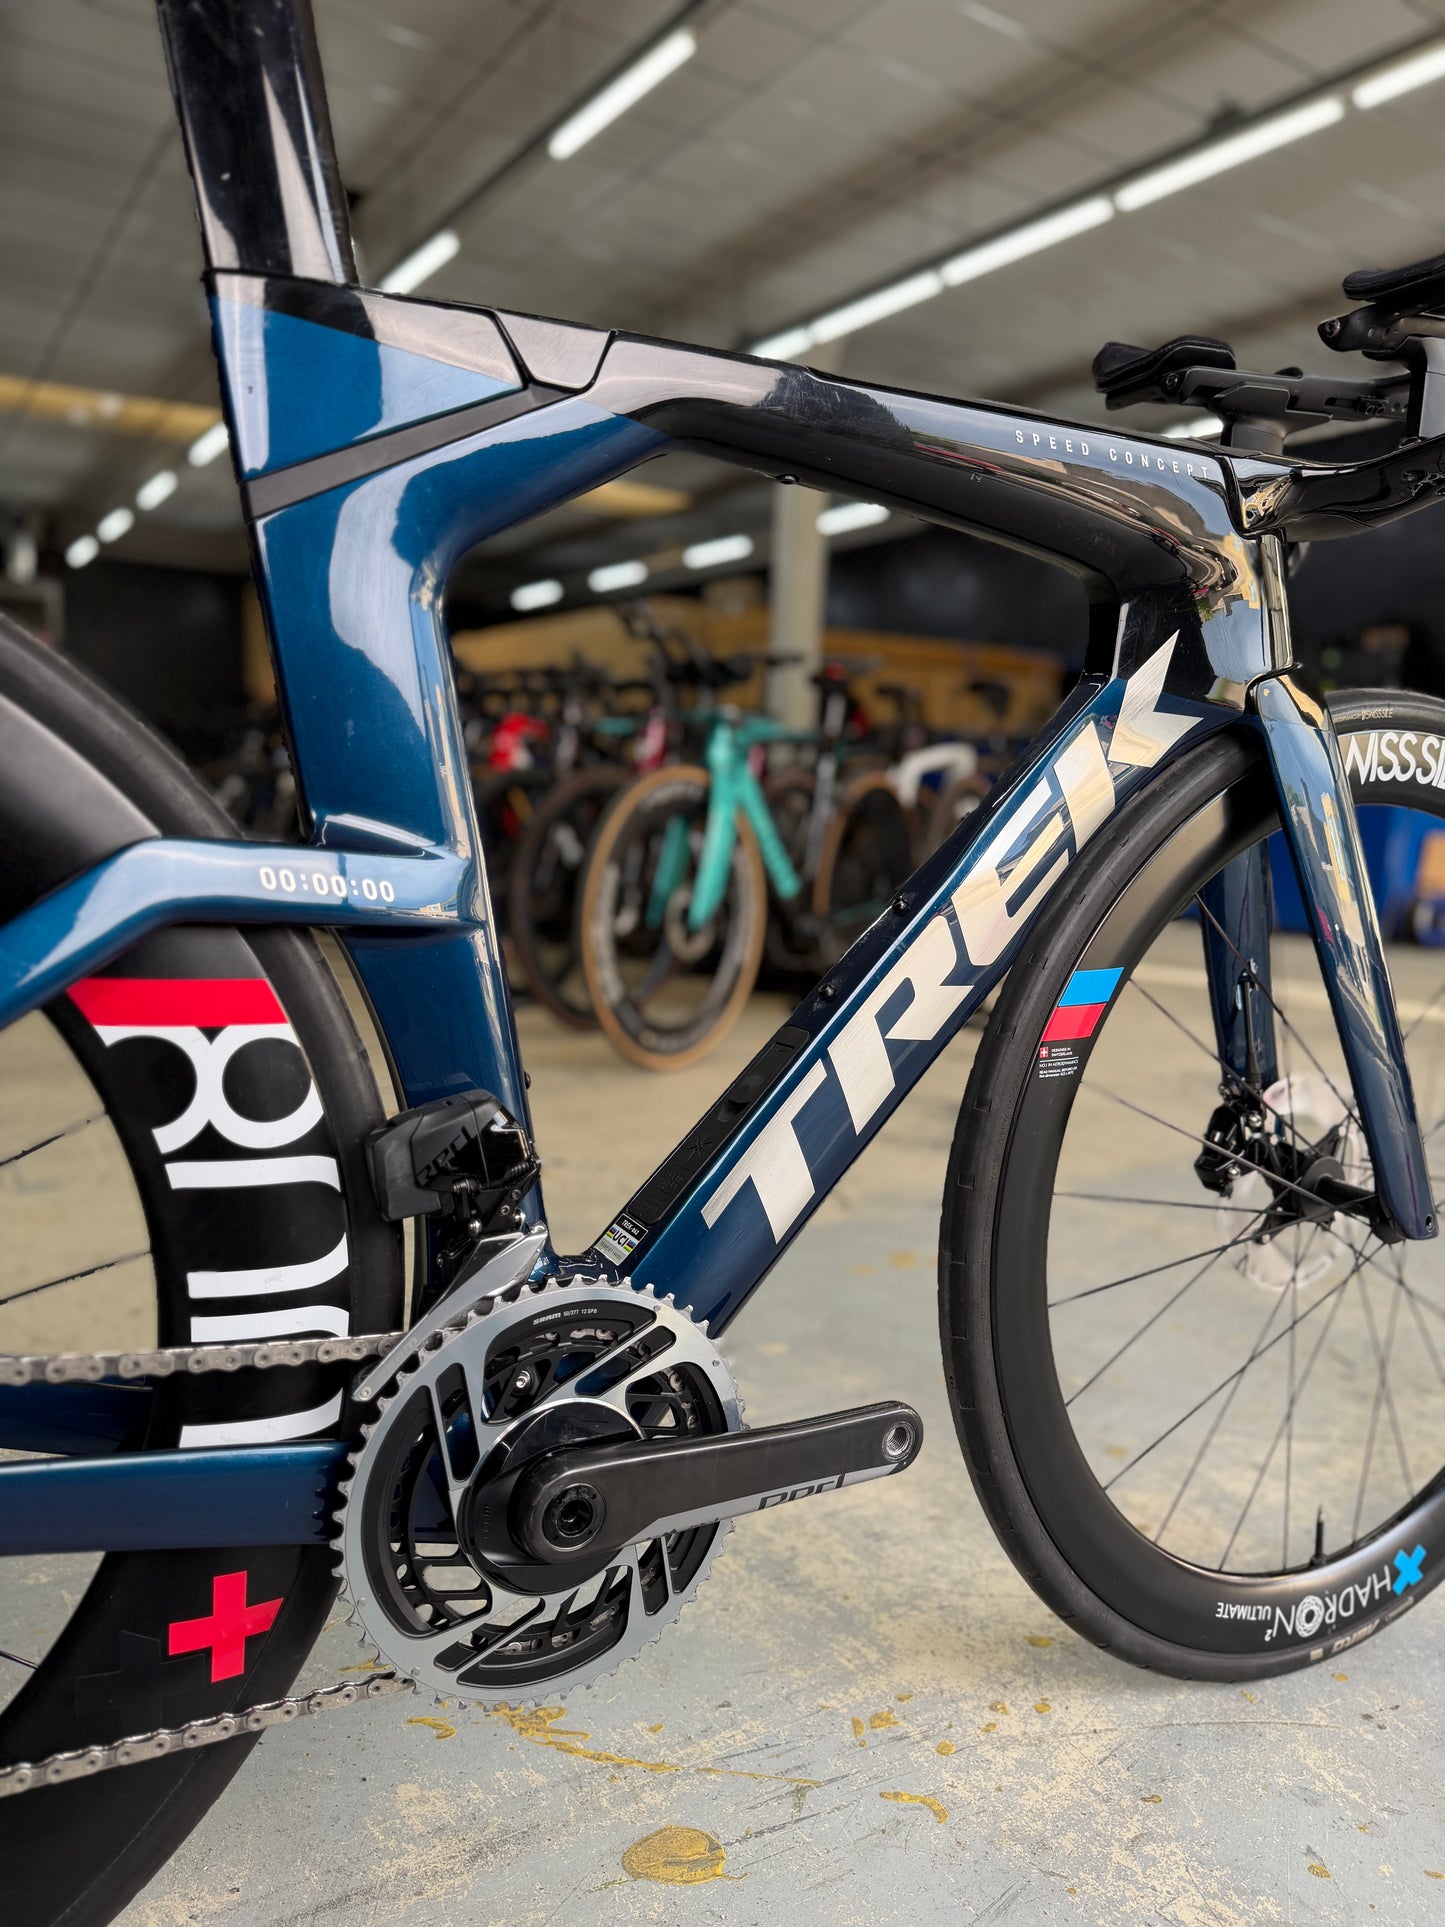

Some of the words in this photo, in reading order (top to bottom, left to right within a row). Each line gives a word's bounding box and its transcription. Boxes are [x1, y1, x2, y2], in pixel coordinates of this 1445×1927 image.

[1015, 430, 1089, 456] SPEED
[1109, 448, 1208, 479] CONCEPT
[259, 867, 395, 902] 00:00:00
[700, 629, 1203, 1244] TREK
[612, 1230, 630, 1247] UCI
[533, 1312, 561, 1325] SRAM
[1215, 1602, 1271, 1621] ULTIMATE
